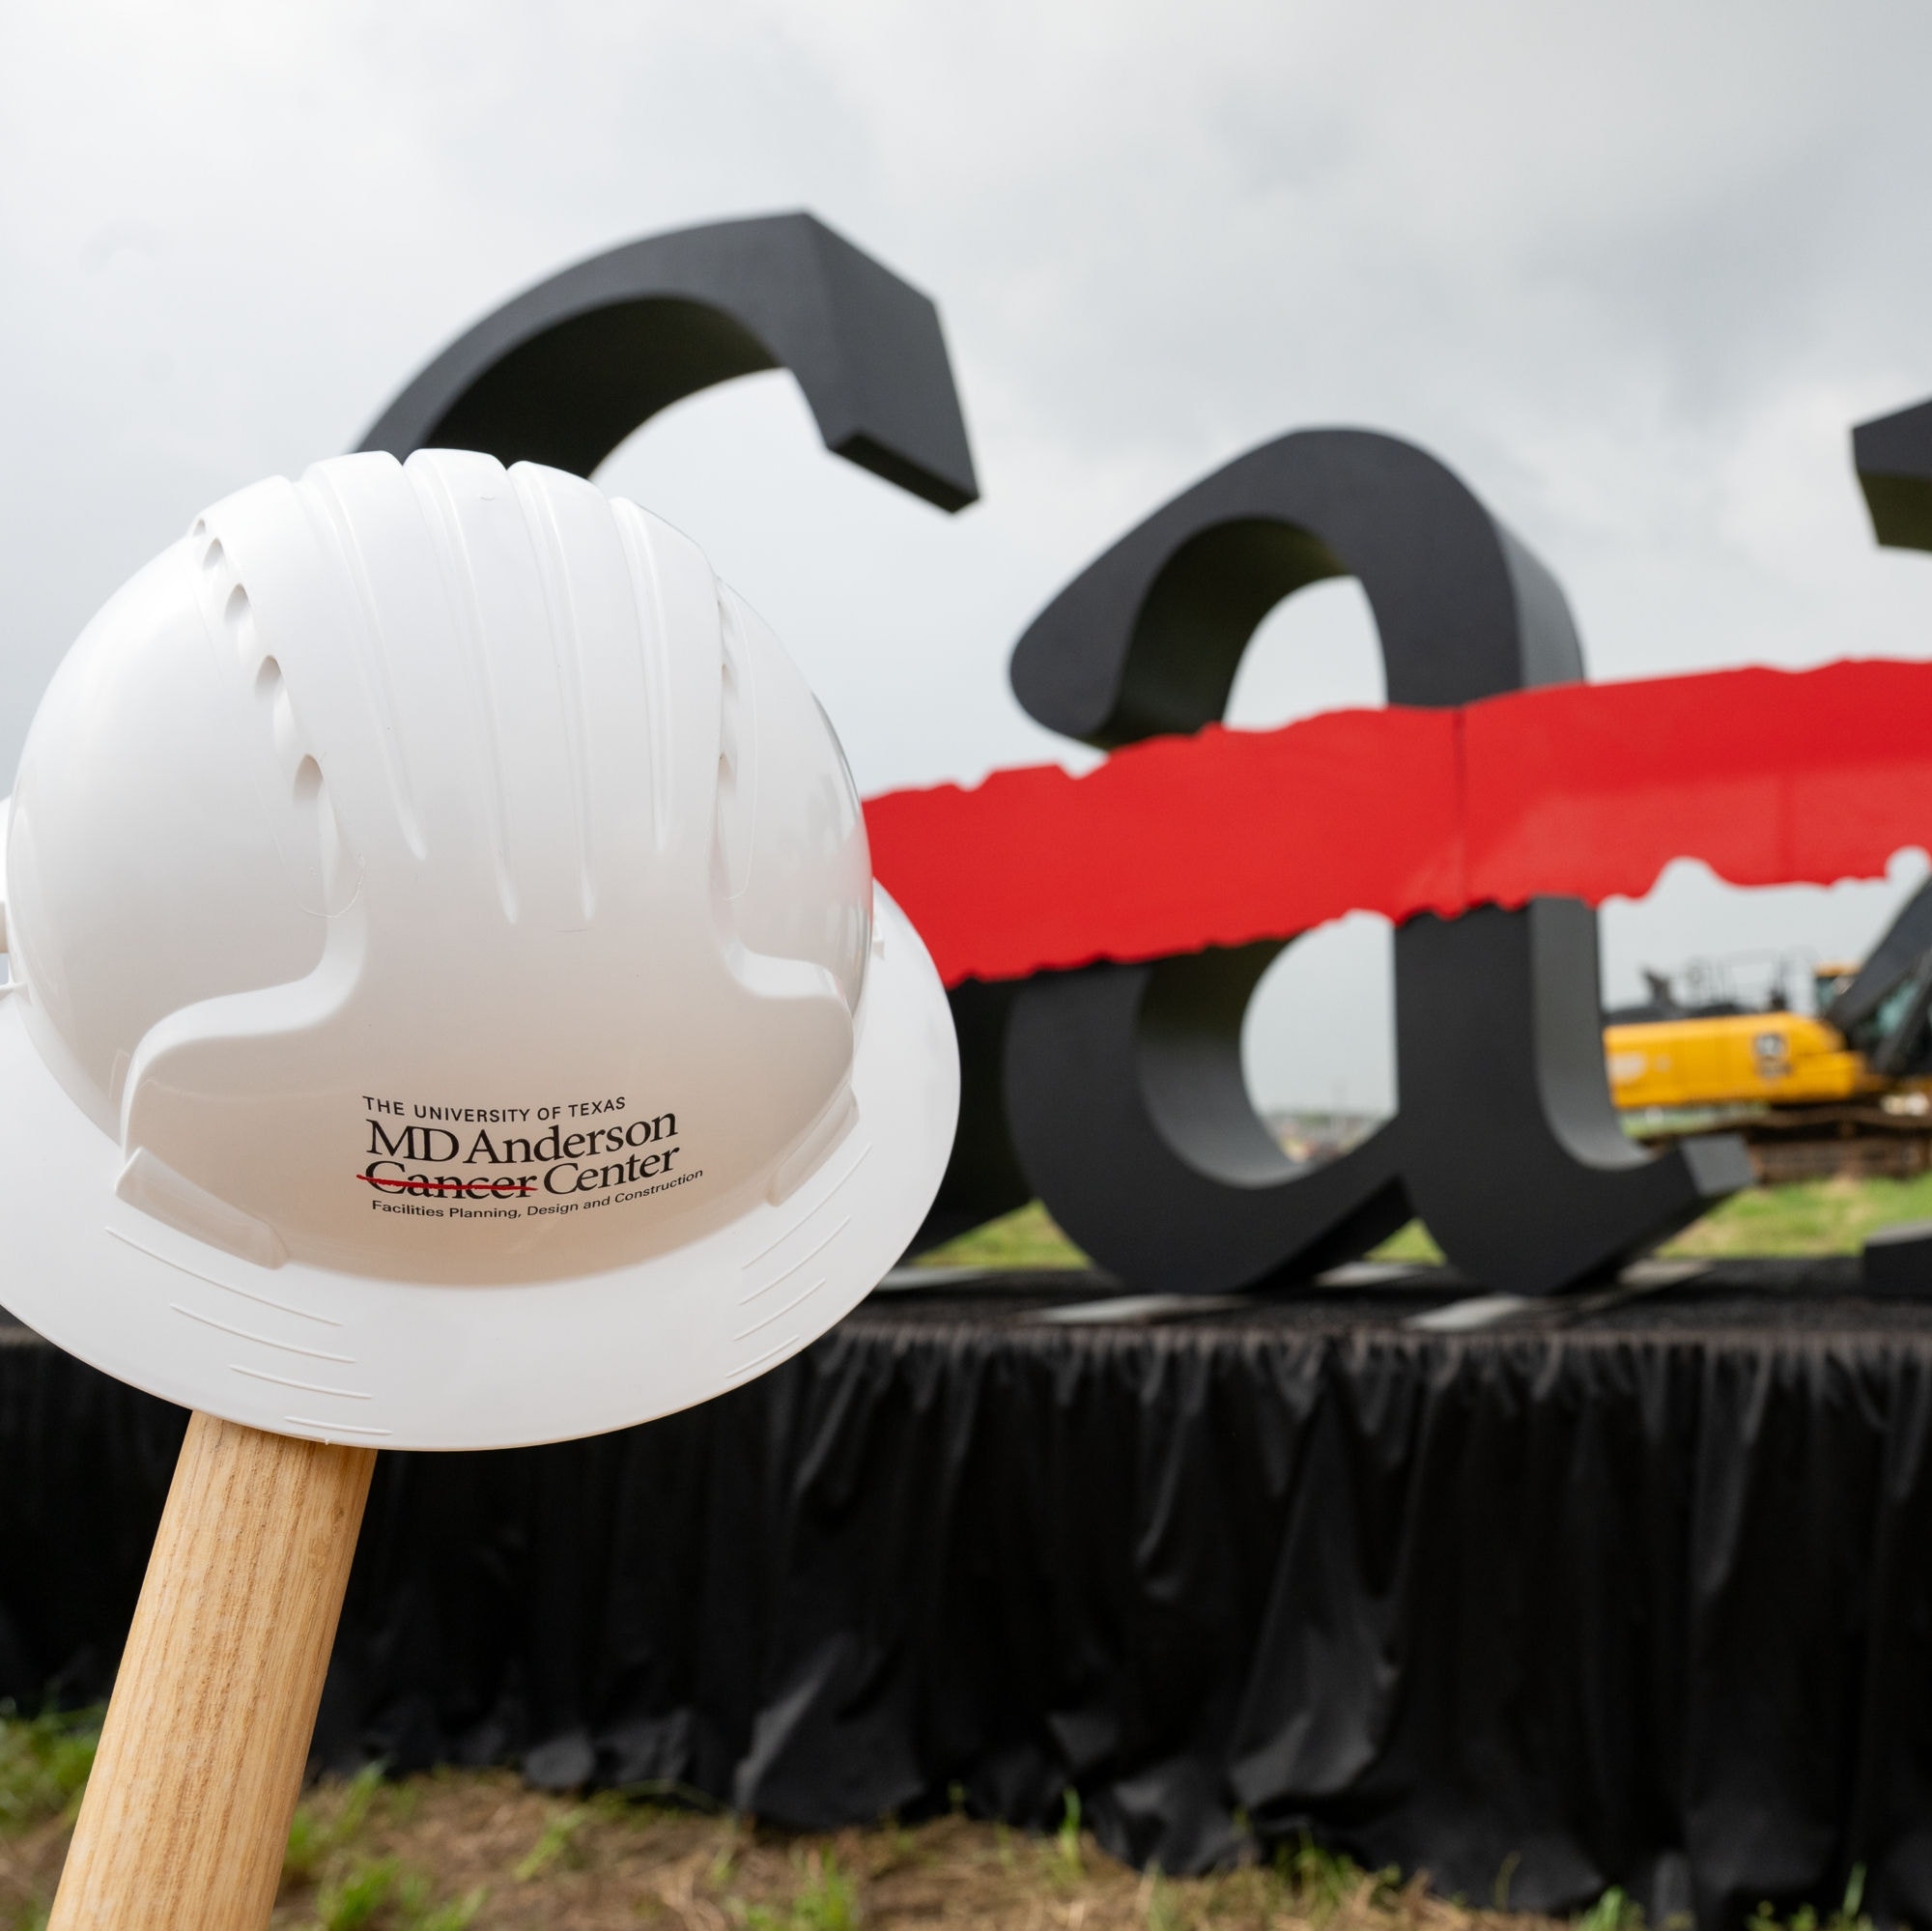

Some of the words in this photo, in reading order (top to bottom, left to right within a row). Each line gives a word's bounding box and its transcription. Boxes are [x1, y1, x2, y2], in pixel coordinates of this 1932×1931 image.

[363, 1095, 406, 1116] THE
[414, 1104, 530, 1122] UNIVERSITY
[537, 1106, 561, 1121] OF
[568, 1096, 626, 1118] TEXAS
[366, 1119, 460, 1162] MD
[463, 1113, 678, 1164] Anderson
[363, 1161, 538, 1200] Cancer
[543, 1148, 680, 1195] Center
[372, 1200, 444, 1218] Facilities
[449, 1207, 522, 1219] Planning,
[527, 1204, 580, 1217] Design
[582, 1195, 611, 1209] and
[614, 1170, 703, 1203] Construction
